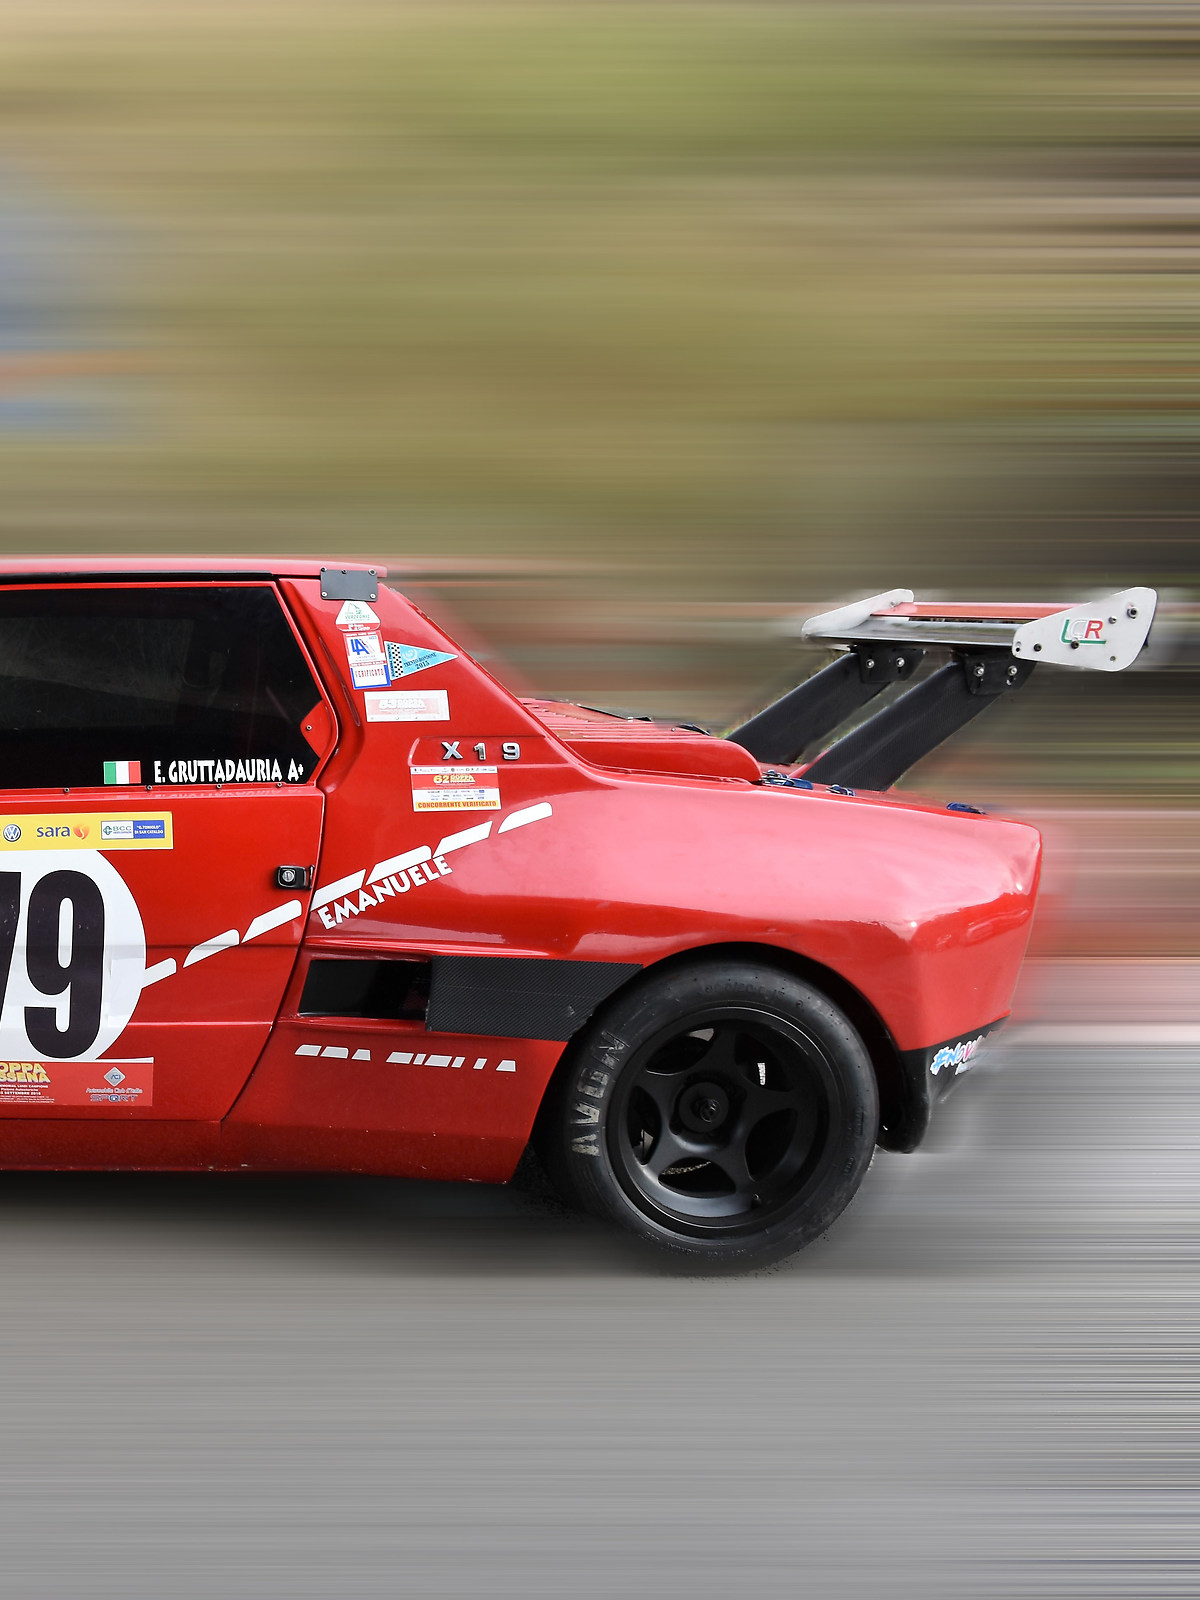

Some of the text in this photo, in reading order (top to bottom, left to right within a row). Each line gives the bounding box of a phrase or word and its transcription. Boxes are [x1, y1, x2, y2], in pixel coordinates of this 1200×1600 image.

[153, 760, 166, 783] E.
[168, 758, 283, 783] GRUTTADAURIA
[36, 826, 70, 838] sara
[317, 856, 453, 930] EMANUELE
[570, 1031, 630, 1157] AVON
